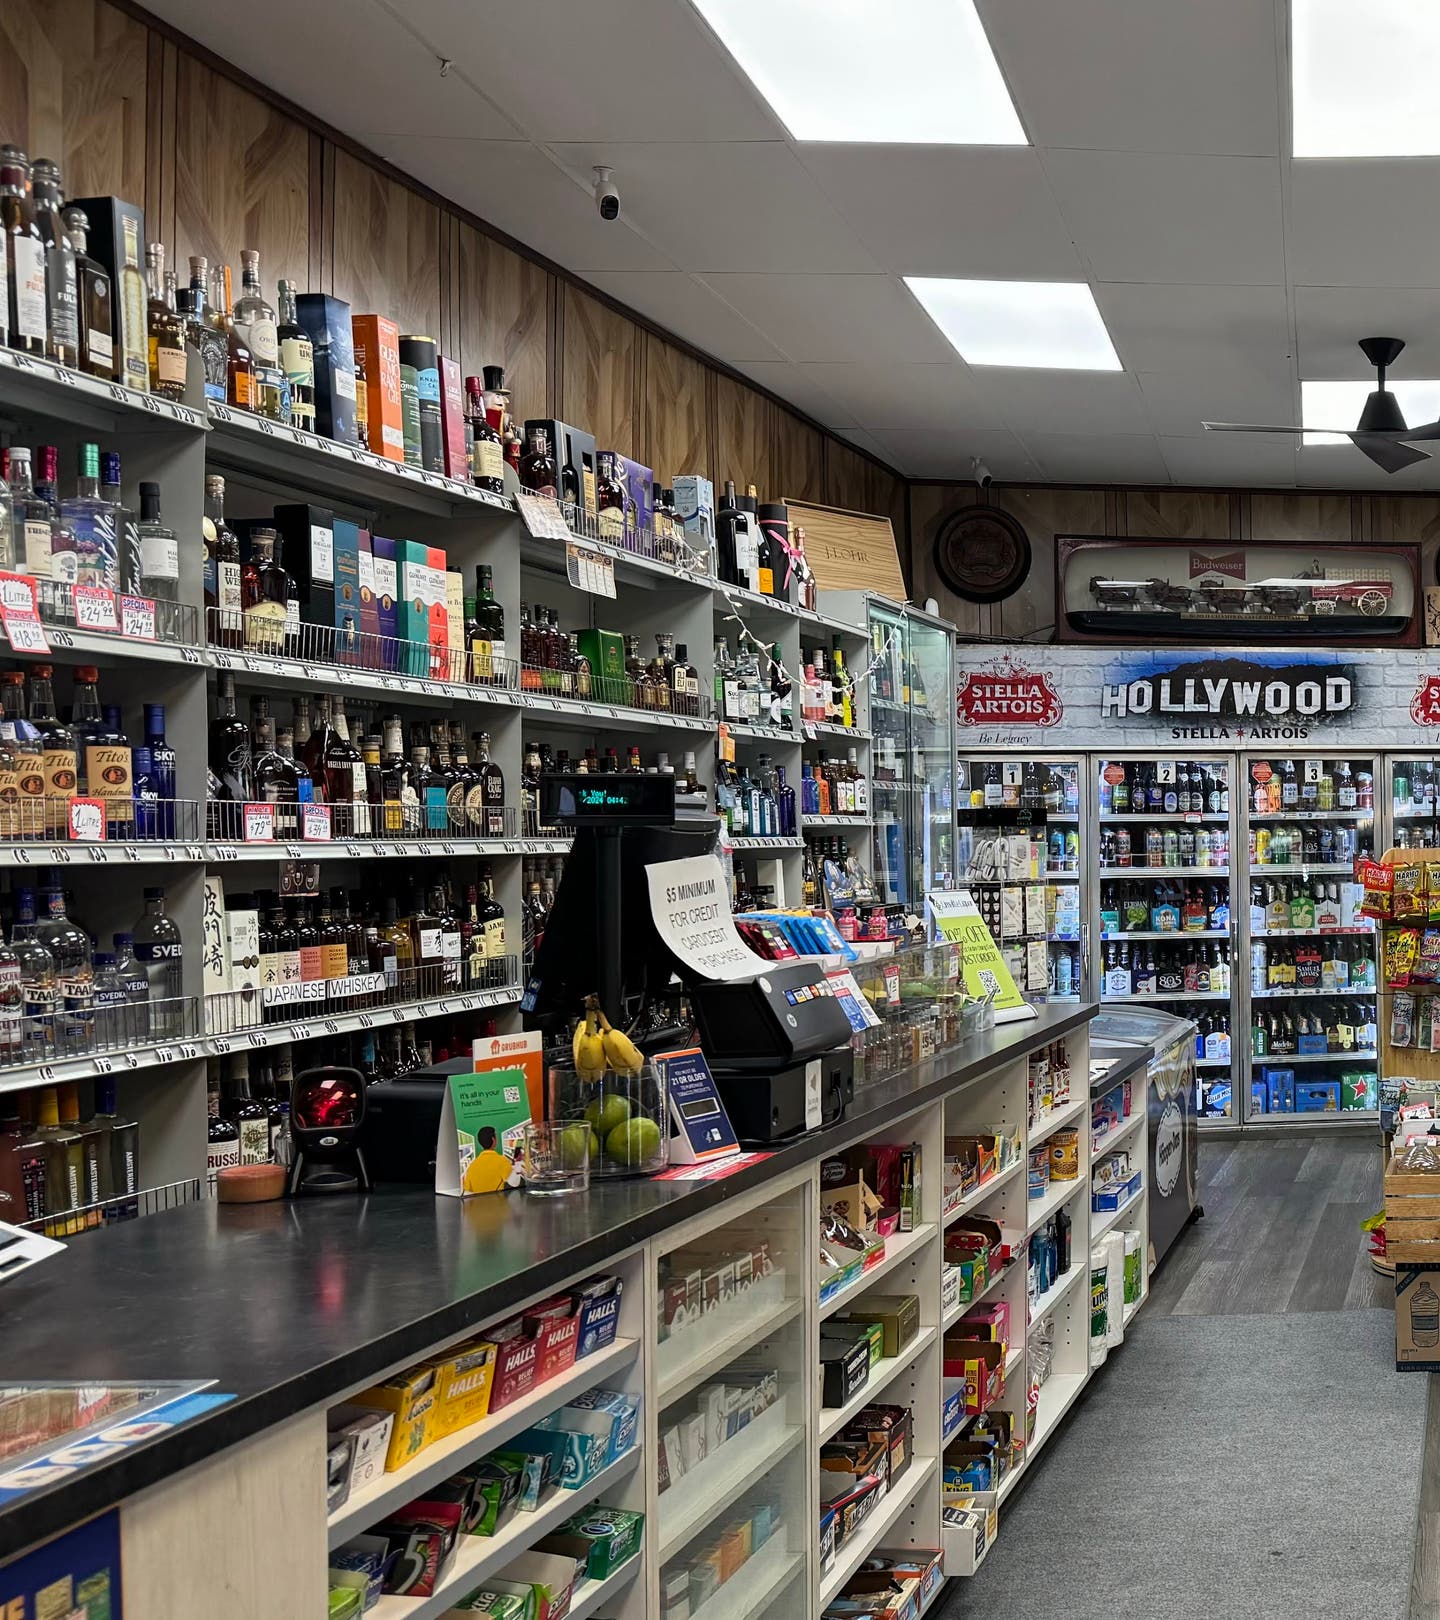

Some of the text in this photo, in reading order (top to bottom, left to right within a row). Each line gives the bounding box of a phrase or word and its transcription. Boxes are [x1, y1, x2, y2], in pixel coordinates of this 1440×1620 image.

[1193, 559, 1243, 570] Budweiser
[8, 592, 32, 603] LITRE
[980, 656, 999, 669] ANNO
[971, 685, 1042, 698] STELLA
[1102, 675, 1352, 718] HOLLYWOOD
[971, 699, 1044, 714] ARTOIS
[978, 733, 1032, 746] Be Legacy
[1171, 727, 1308, 740] STELLA ARTOIS
[96, 750, 130, 763] Tito's
[1009, 770, 1015, 784] 1
[1163, 769, 1170, 782] 2
[1310, 768, 1318, 781] 3
[82, 816, 101, 829] LITRE
[1395, 870, 1420, 880] HARIBO
[666, 879, 716, 903] $5 MINIMUM
[670, 903, 720, 929] FOR CREDIT
[1155, 915, 1176, 923] KONA
[965, 925, 987, 943] OFF
[698, 948, 747, 971] PURCHASES
[1296, 964, 1320, 973] SAMUEL
[1297, 970, 1320, 978] ADAMS
[1159, 975, 1182, 987] 805
[265, 974, 382, 1003] JAPANESE WHISKEY
[99, 991, 127, 1001] SVEDKA
[501, 1040, 528, 1052] GRUBHUB
[1271, 1041, 1294, 1049] Modelo
[671, 1076, 680, 1086] 21
[687, 1072, 707, 1083] OLDER
[485, 1089, 500, 1099] your
[126, 1151, 134, 1194] AMSTERDAM
[586, 1299, 617, 1325] HALLS
[547, 1322, 576, 1348] HALLS
[505, 1343, 536, 1372] HALLS
[447, 1372, 486, 1399] HALLS
[465, 1478, 494, 1534] 5
[398, 1531, 431, 1594] 5
